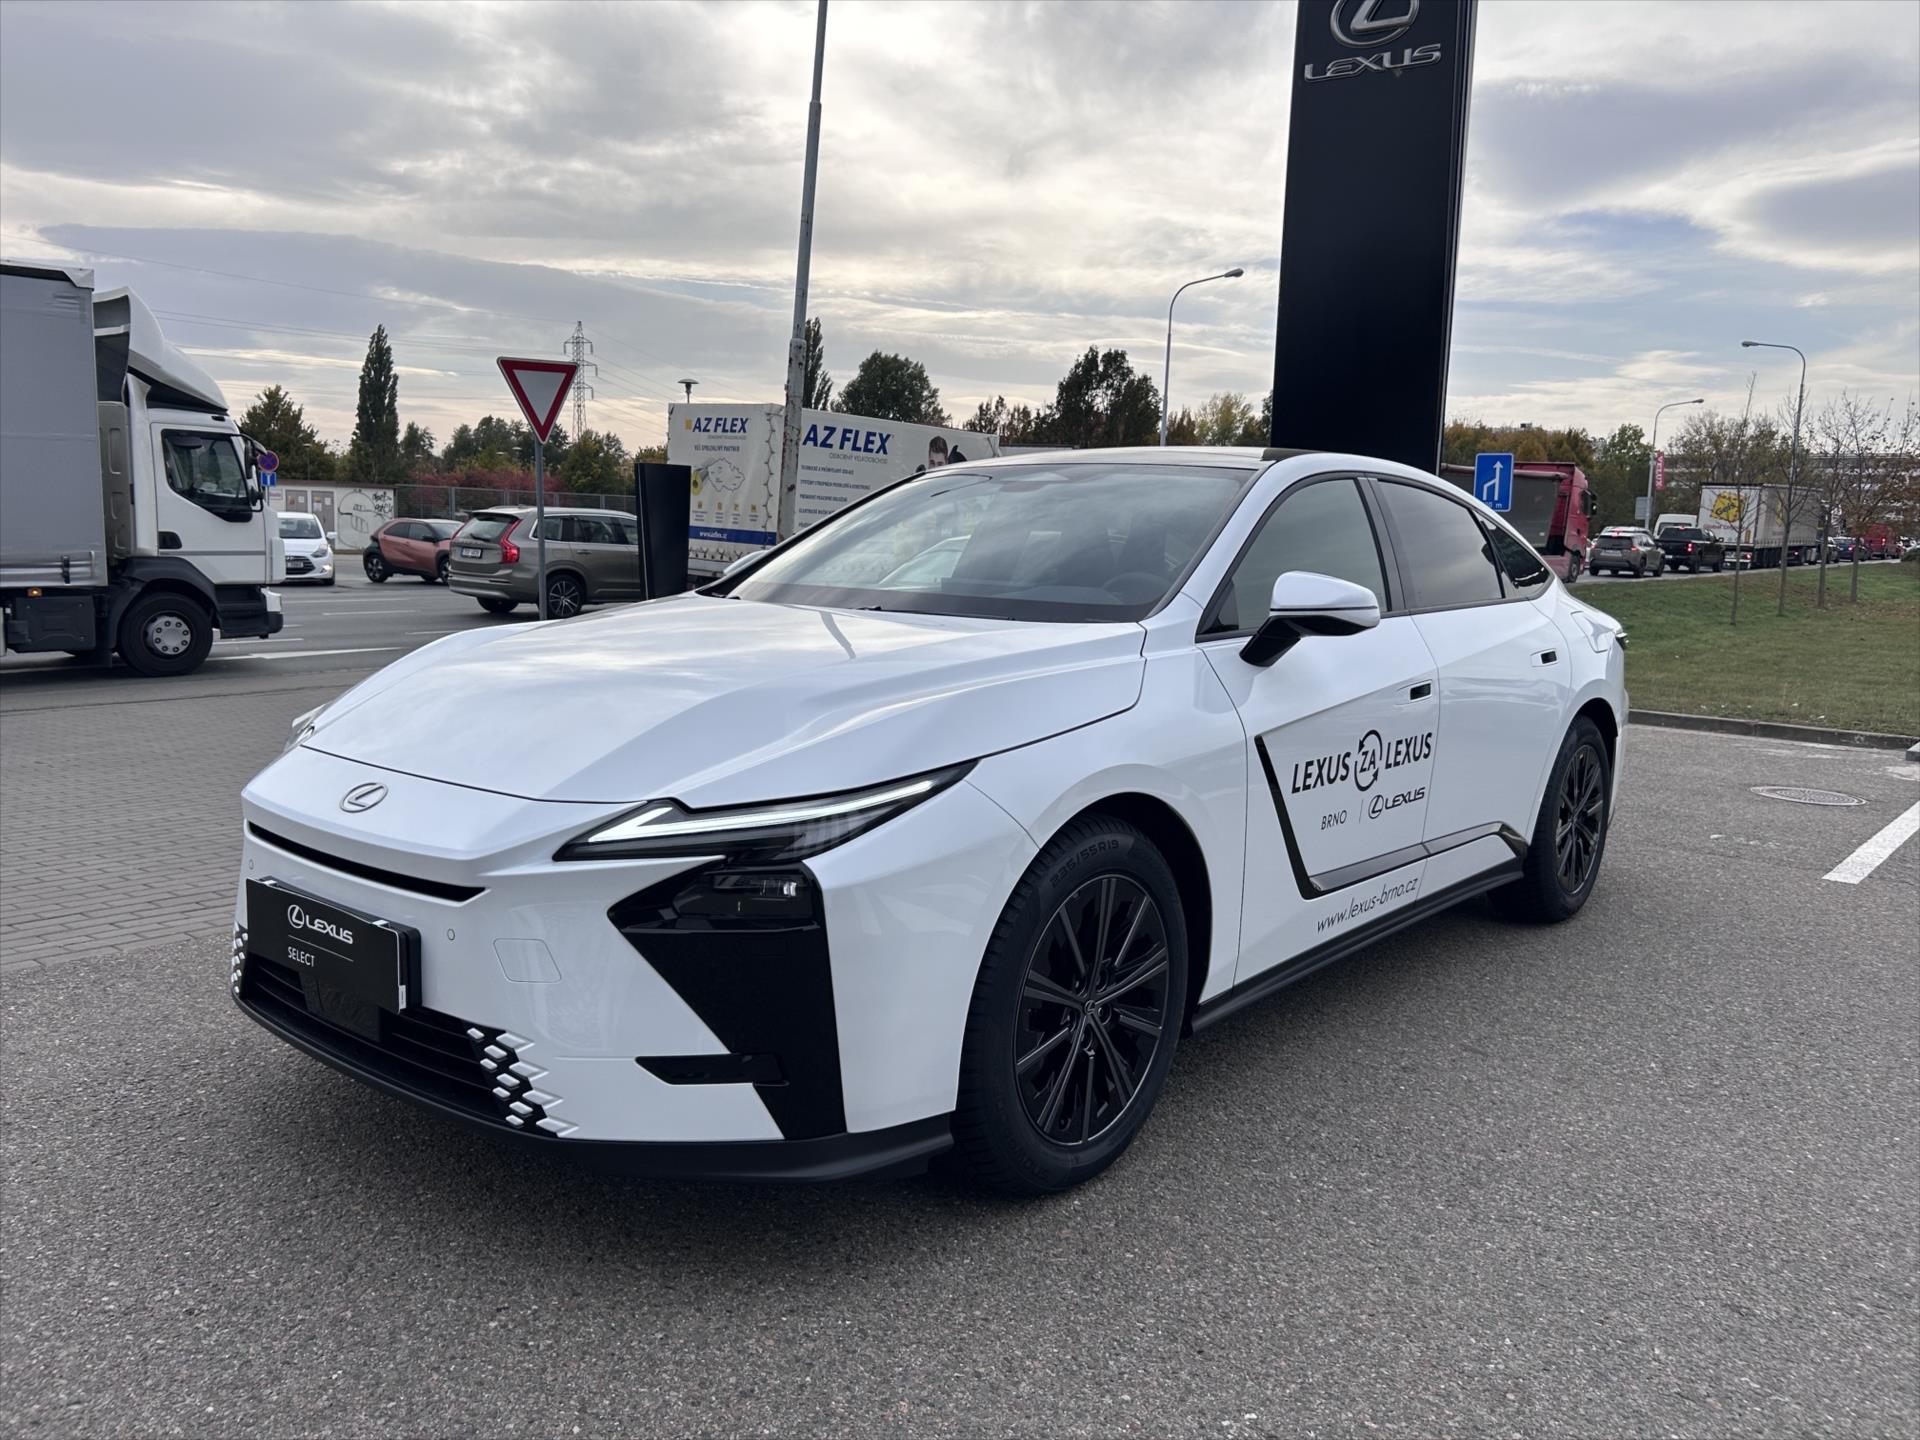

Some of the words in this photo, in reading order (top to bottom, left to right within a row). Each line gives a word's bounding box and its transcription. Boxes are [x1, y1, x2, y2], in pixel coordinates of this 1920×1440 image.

[1304, 43, 1441, 82] LEXUS
[692, 417, 713, 433] AZ
[713, 417, 749, 434] FLEX
[802, 423, 837, 449] AZ
[838, 427, 892, 455] FLEX
[1291, 751, 1352, 794] LEXUS
[1359, 748, 1377, 773] ZA
[1384, 732, 1433, 770] LEXUS
[1320, 809, 1348, 831] BRNO
[1384, 786, 1426, 810] LEXUS
[1316, 877, 1419, 934] www.lexus-brno.cz
[305, 914, 354, 945] LEXUS
[287, 946, 316, 968] SELECT
